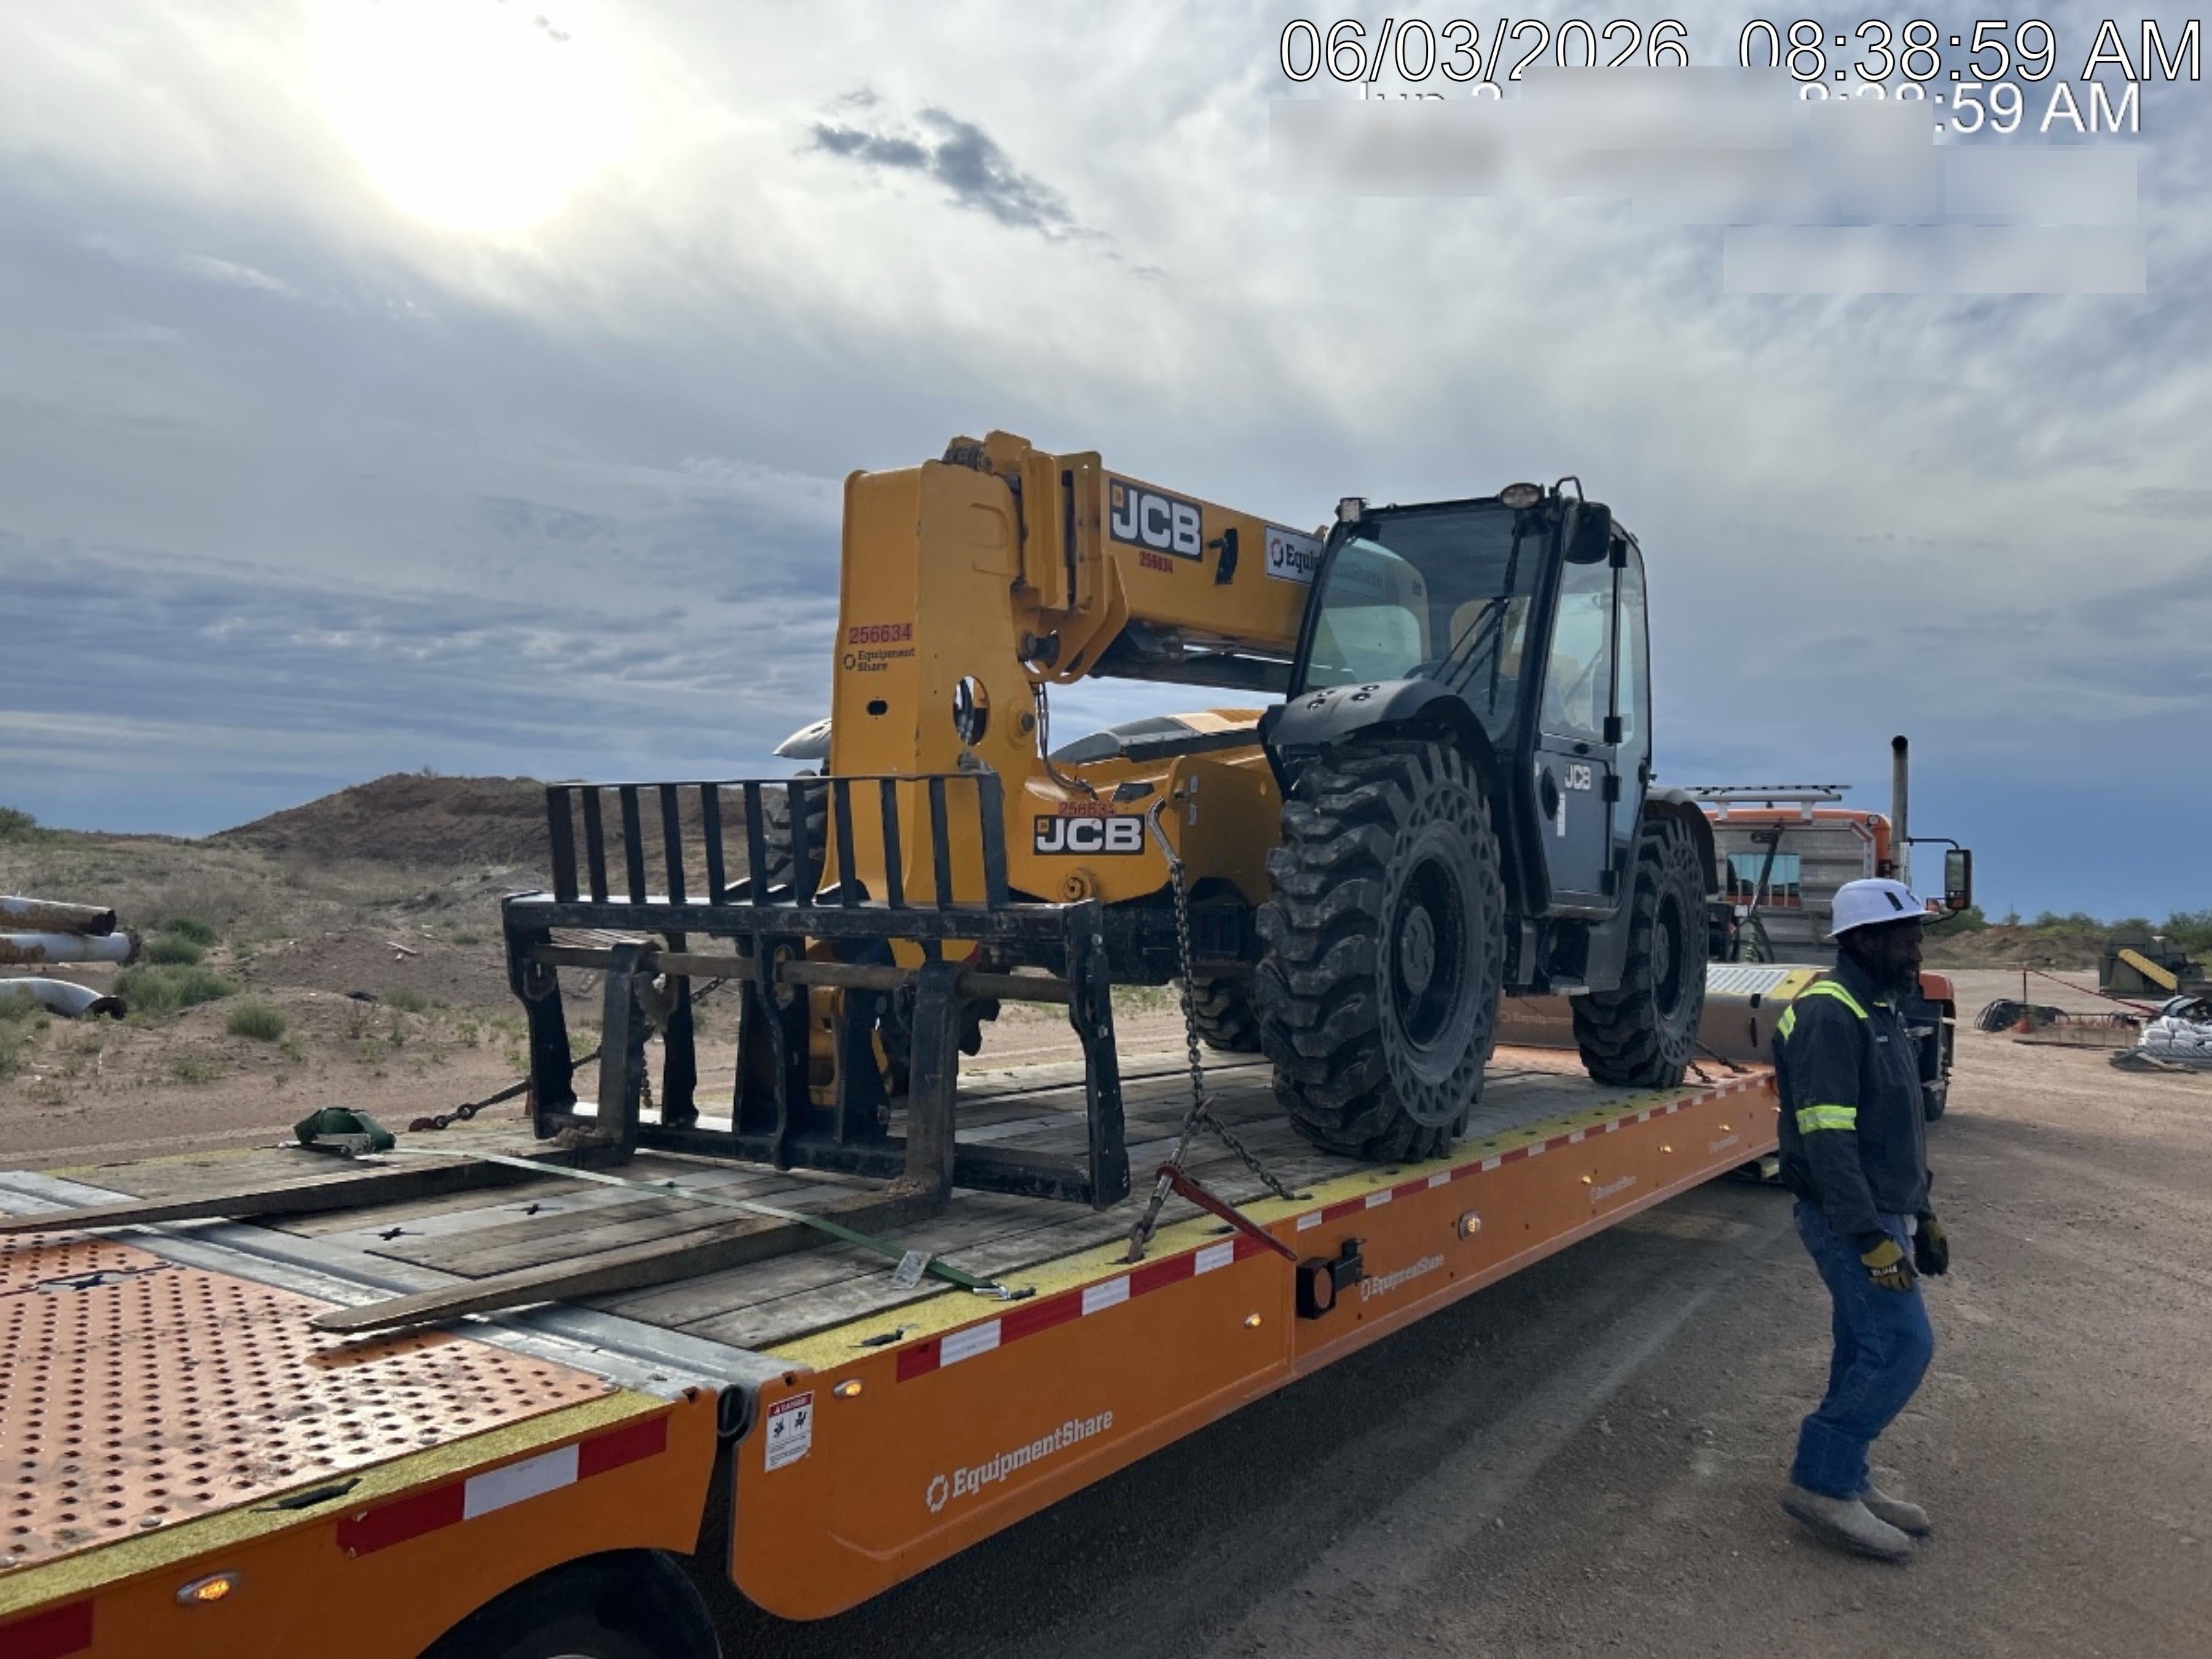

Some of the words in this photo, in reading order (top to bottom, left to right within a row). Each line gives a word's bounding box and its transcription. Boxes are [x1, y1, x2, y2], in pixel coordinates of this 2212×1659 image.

[1113, 490, 1201, 555] JCB
[849, 623, 912, 644] 256634
[858, 648, 915, 661] Equipment
[1564, 764, 1591, 790] JCB
[1037, 818, 1142, 851] JCB
[952, 1410, 1113, 1498] EquipmentShare
